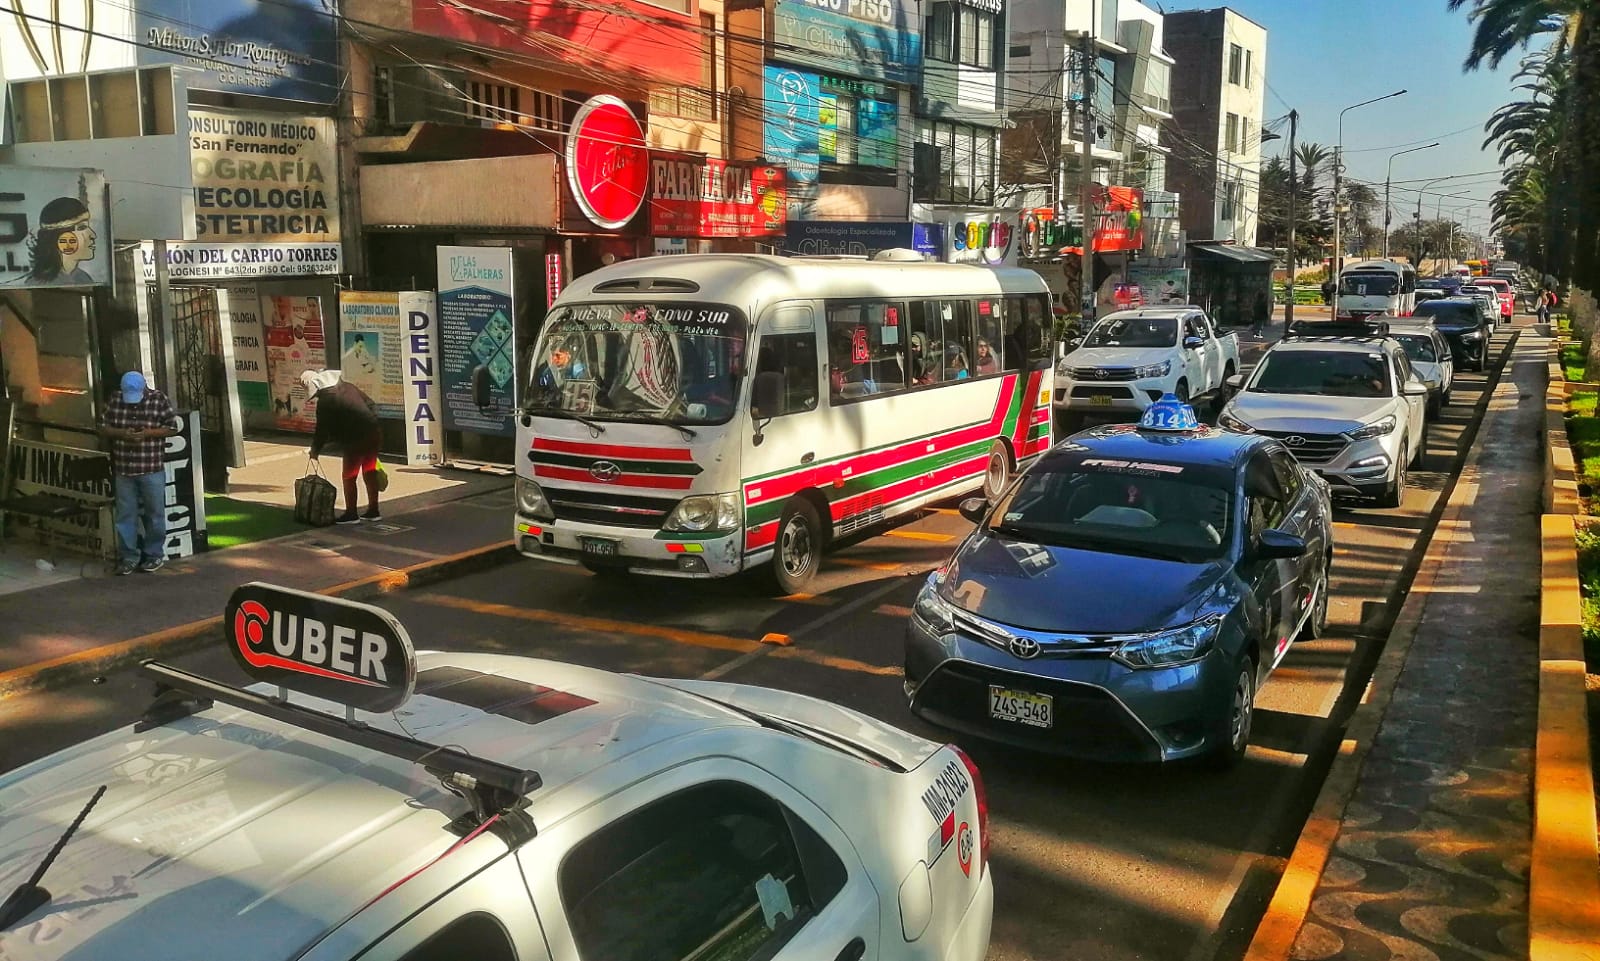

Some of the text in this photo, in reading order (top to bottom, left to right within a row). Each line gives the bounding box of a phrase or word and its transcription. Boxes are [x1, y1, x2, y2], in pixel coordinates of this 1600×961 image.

[271, 120, 316, 141] MÉDICO
[652, 159, 754, 205] FARMACIA
[193, 184, 327, 210] ECOLOGÍA
[199, 248, 228, 264] DEL
[231, 248, 284, 264] CARPIO
[286, 247, 338, 263] TORRES
[463, 256, 477, 267] LAS
[258, 263, 278, 275] PISO
[279, 262, 296, 275] Cel:
[463, 268, 504, 281] PALMERAS
[654, 309, 693, 322] CONO
[696, 310, 730, 324] SUR
[407, 310, 436, 446] DENTAL
[1143, 412, 1180, 428] 314
[271, 610, 388, 683] UBER
[993, 694, 1049, 722] Z4S-548
